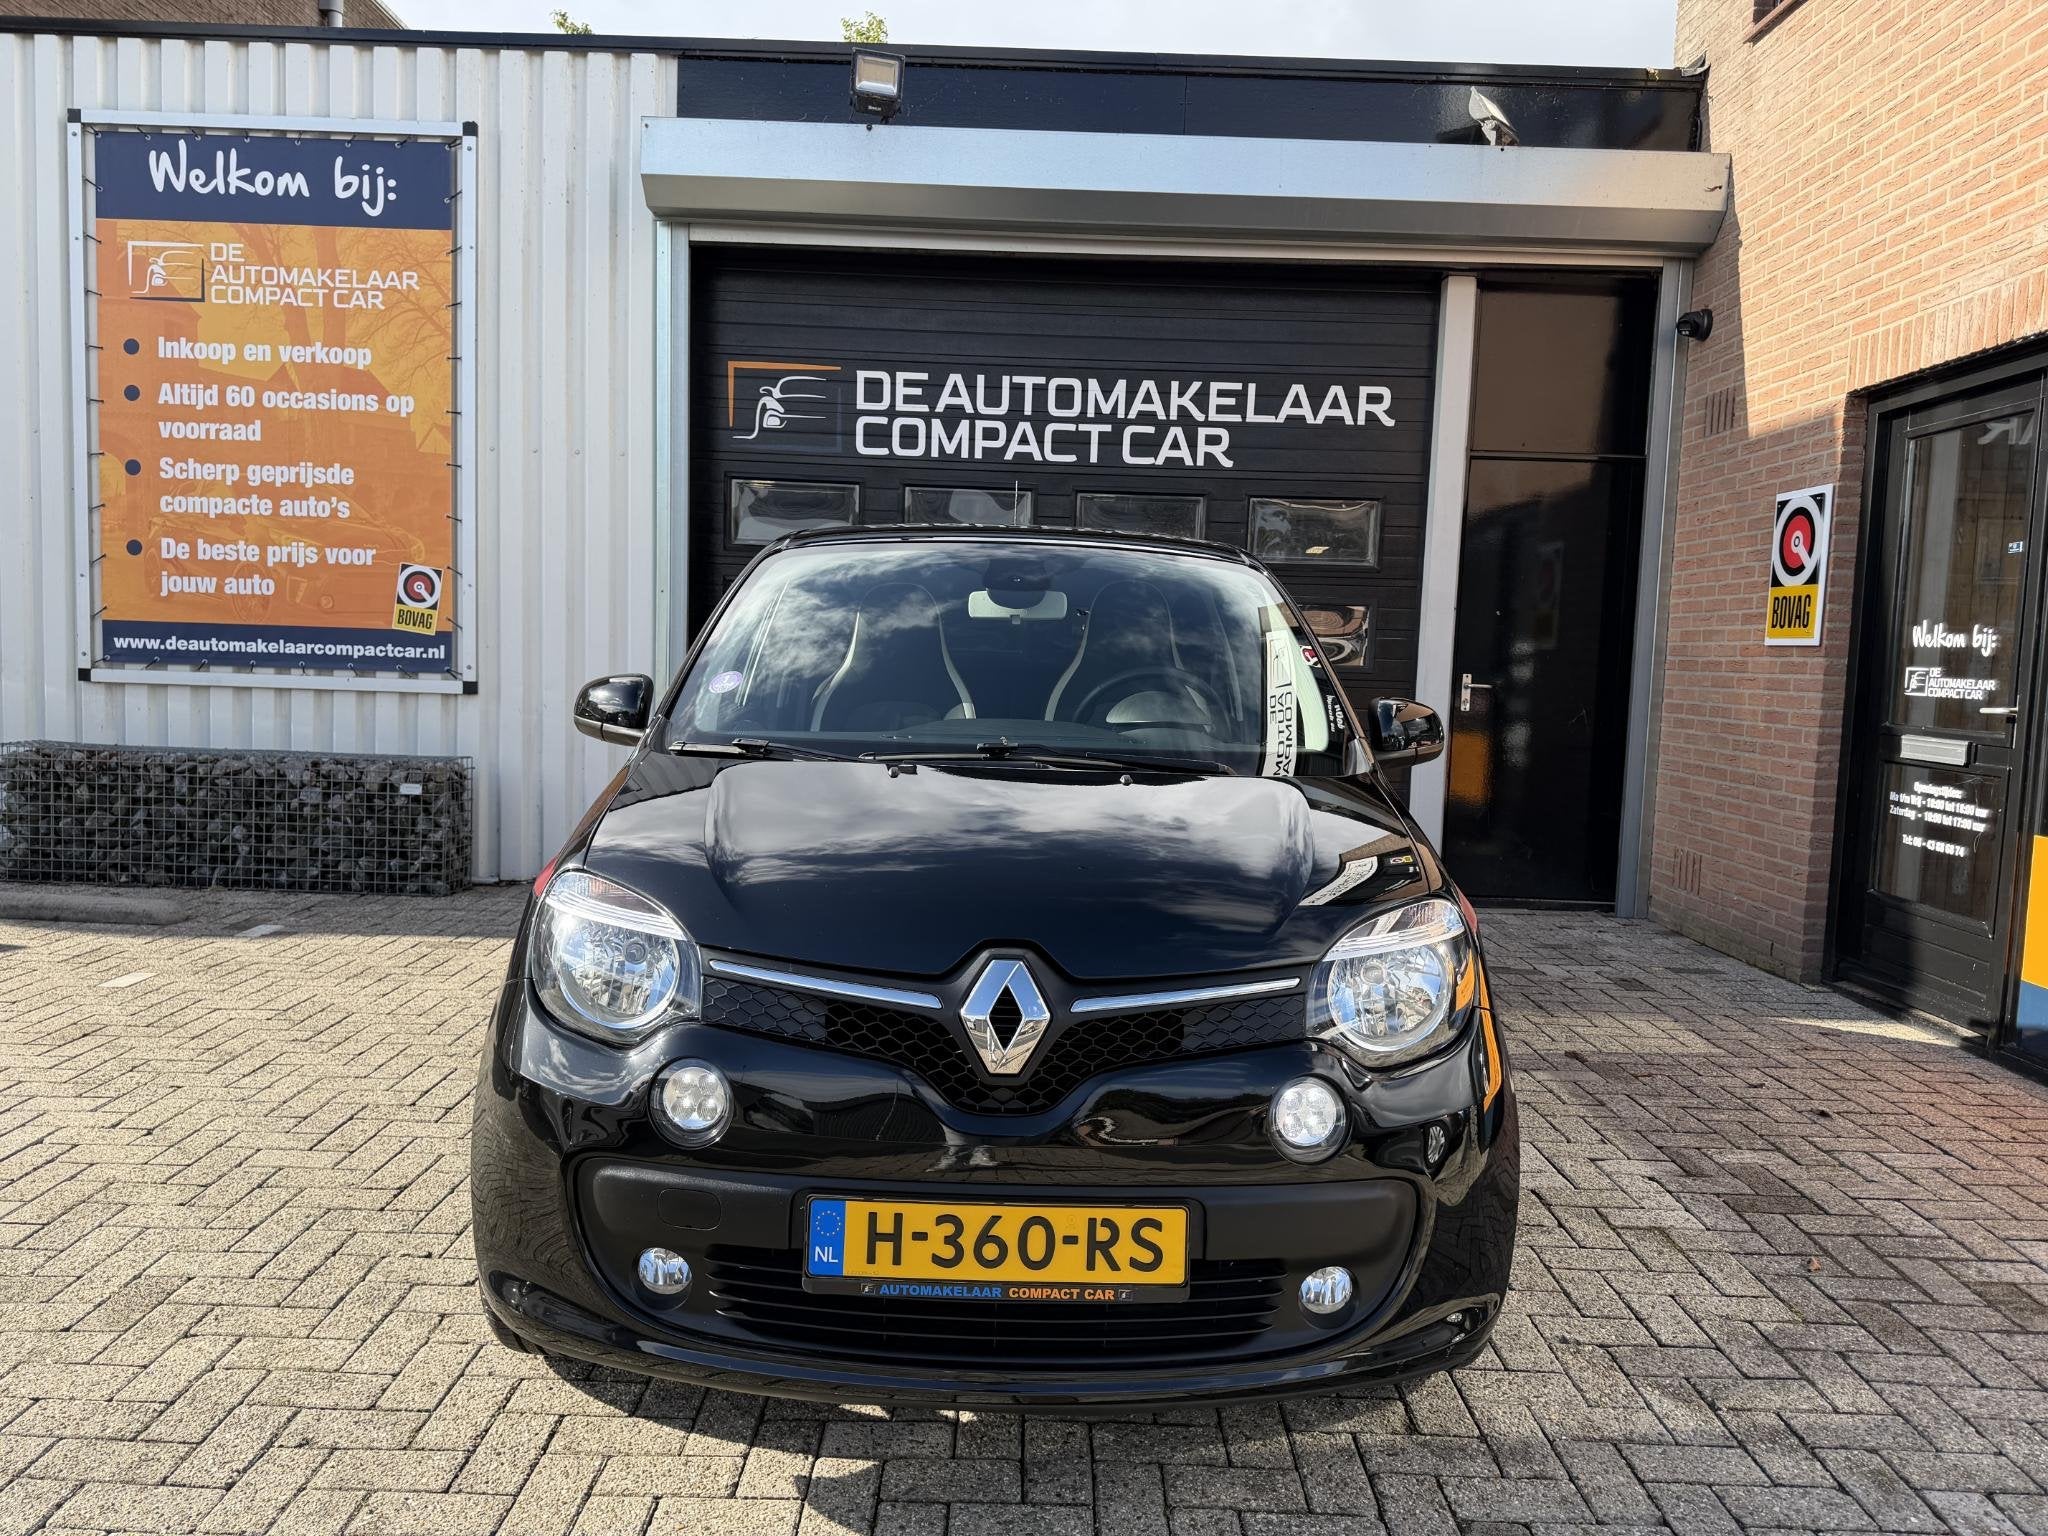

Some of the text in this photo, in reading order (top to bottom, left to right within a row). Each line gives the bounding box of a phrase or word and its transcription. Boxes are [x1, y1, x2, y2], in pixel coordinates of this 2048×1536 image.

[148, 139, 397, 217] Welkom bij:
[210, 243, 244, 262] DE
[210, 265, 419, 290] AUTOMAKELAAR
[210, 286, 385, 310] COMPACT CAR
[158, 337, 372, 370] Inkoop en verkoop
[158, 382, 414, 417] Altijd 60 occasions op
[856, 369, 1396, 427] DE AUTOMAKELAAR
[158, 419, 261, 441] voorraad
[855, 416, 1234, 468] COMPACT CAR
[159, 458, 354, 488] Scherp geprijsde
[160, 494, 350, 518] compacte auto's
[161, 537, 376, 568] De beste prijs voor
[160, 571, 275, 597] jouw auto
[397, 605, 433, 630] BOVAG
[1771, 594, 1811, 630] BOVAG
[113, 635, 445, 660] www.deautomakelaarcompactcar.nl
[1912, 620, 1997, 657] Welkom bij:
[1929, 667, 1941, 677] DE
[1929, 678, 1996, 691] AUTOMAKELAAR
[1928, 688, 1983, 700] COMPACT CAR
[1890, 804, 1915, 820] Zaterdag
[814, 1245, 838, 1263] NL
[865, 1211, 1164, 1273] H-360-RS
[880, 1284, 1115, 1301] AUTOMAKELAAR COMPACT CAR
